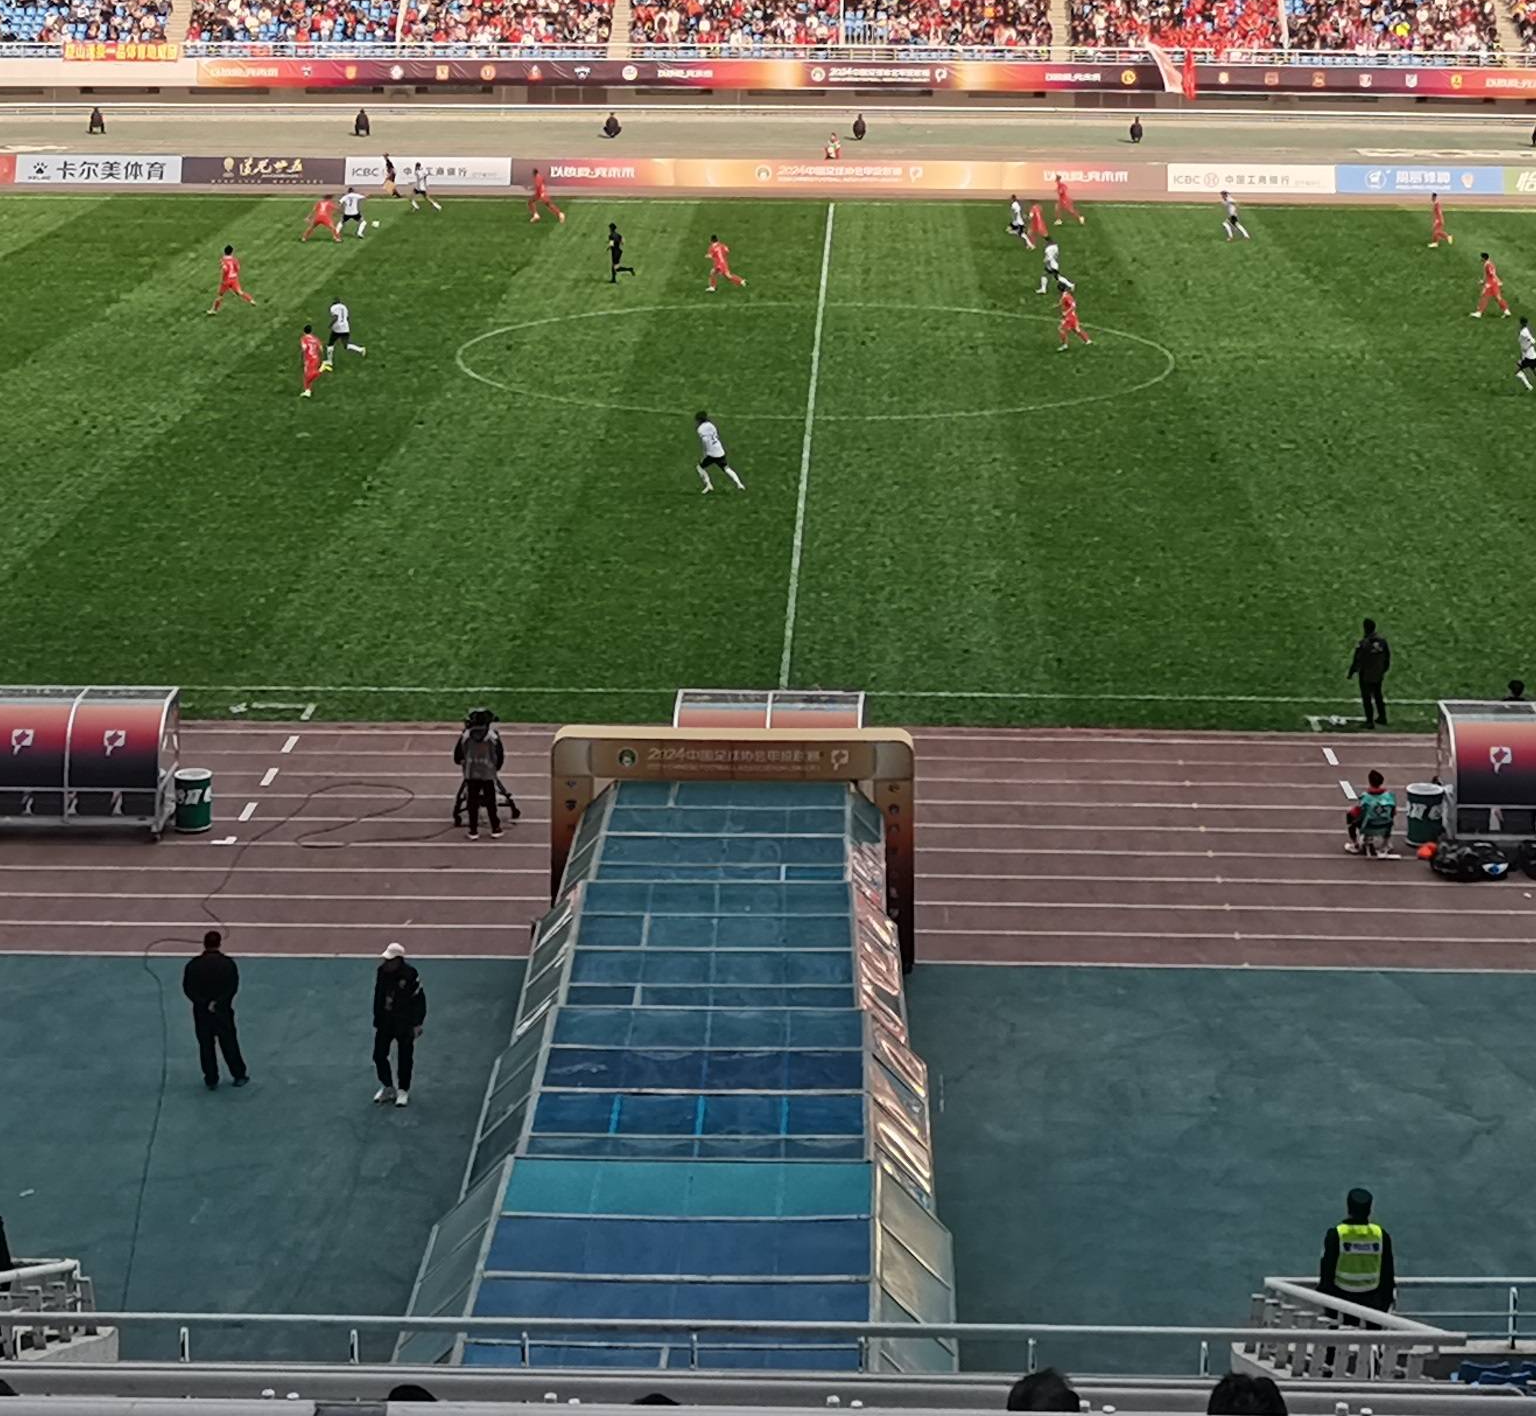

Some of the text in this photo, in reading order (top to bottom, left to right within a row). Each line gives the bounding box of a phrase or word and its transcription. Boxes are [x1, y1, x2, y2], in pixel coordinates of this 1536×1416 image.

[56, 160, 167, 181] 卡尔美体育
